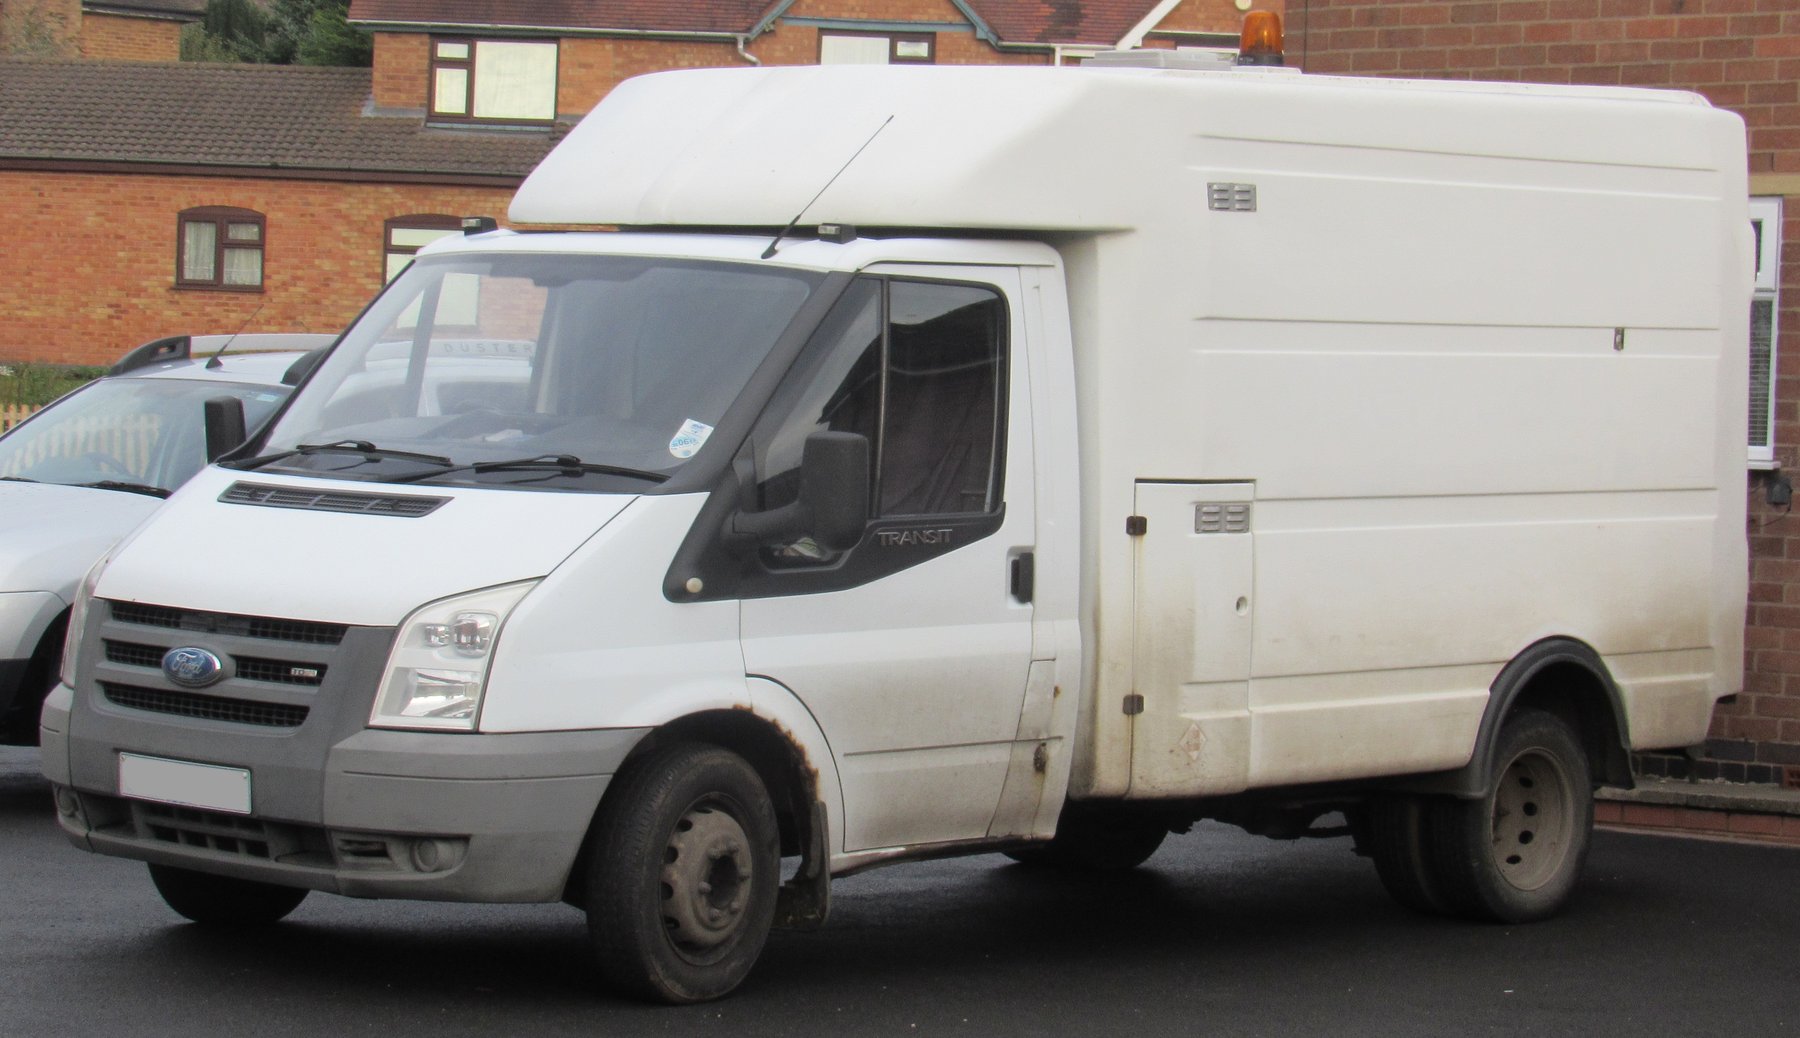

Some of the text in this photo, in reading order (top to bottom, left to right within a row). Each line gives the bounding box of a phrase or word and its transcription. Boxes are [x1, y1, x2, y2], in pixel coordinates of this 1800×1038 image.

[443, 343, 534, 354] DUSTER
[878, 528, 953, 546] TRANSIT
[172, 652, 205, 675] Ford
